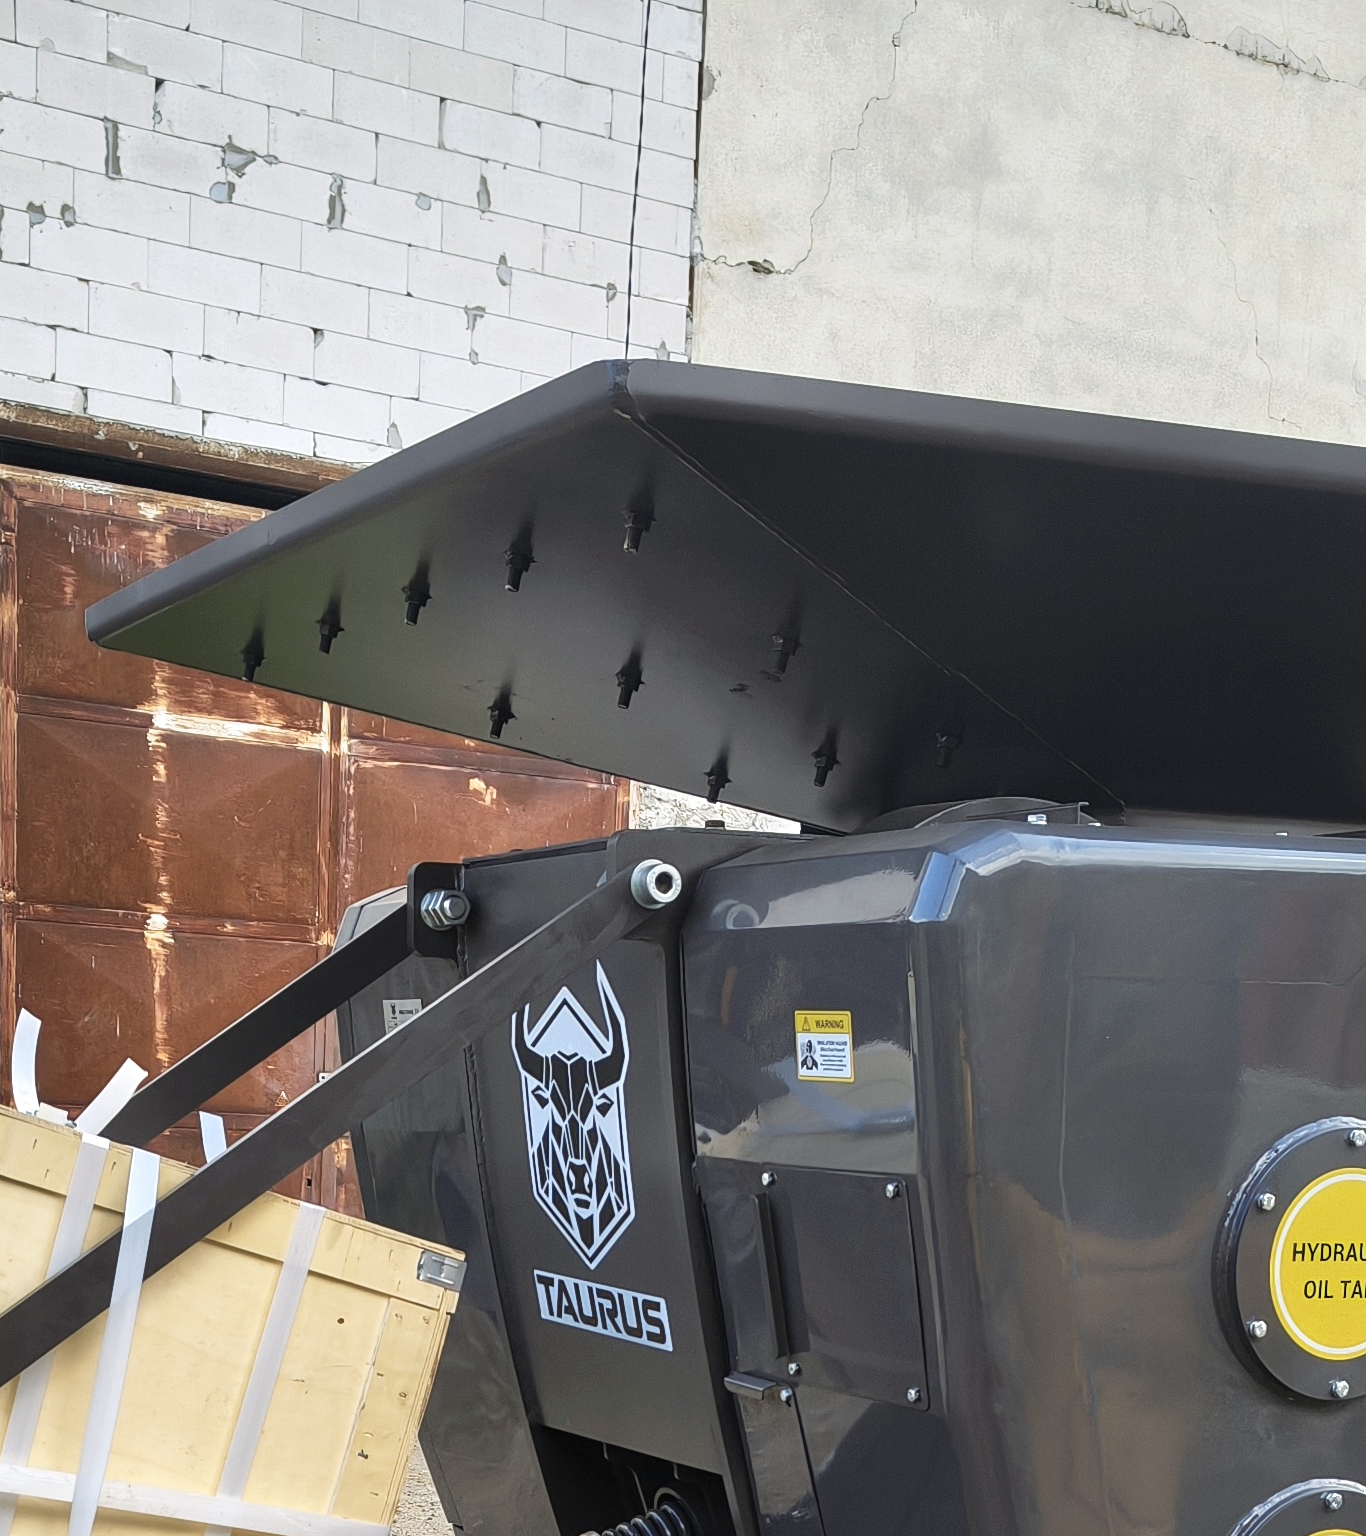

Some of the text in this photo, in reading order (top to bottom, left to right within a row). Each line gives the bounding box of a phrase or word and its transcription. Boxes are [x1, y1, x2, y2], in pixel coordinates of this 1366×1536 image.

[815, 1019, 844, 1030] WARNING
[1303, 1280, 1334, 1299] OIL
[536, 1274, 666, 1345] TAURUS
